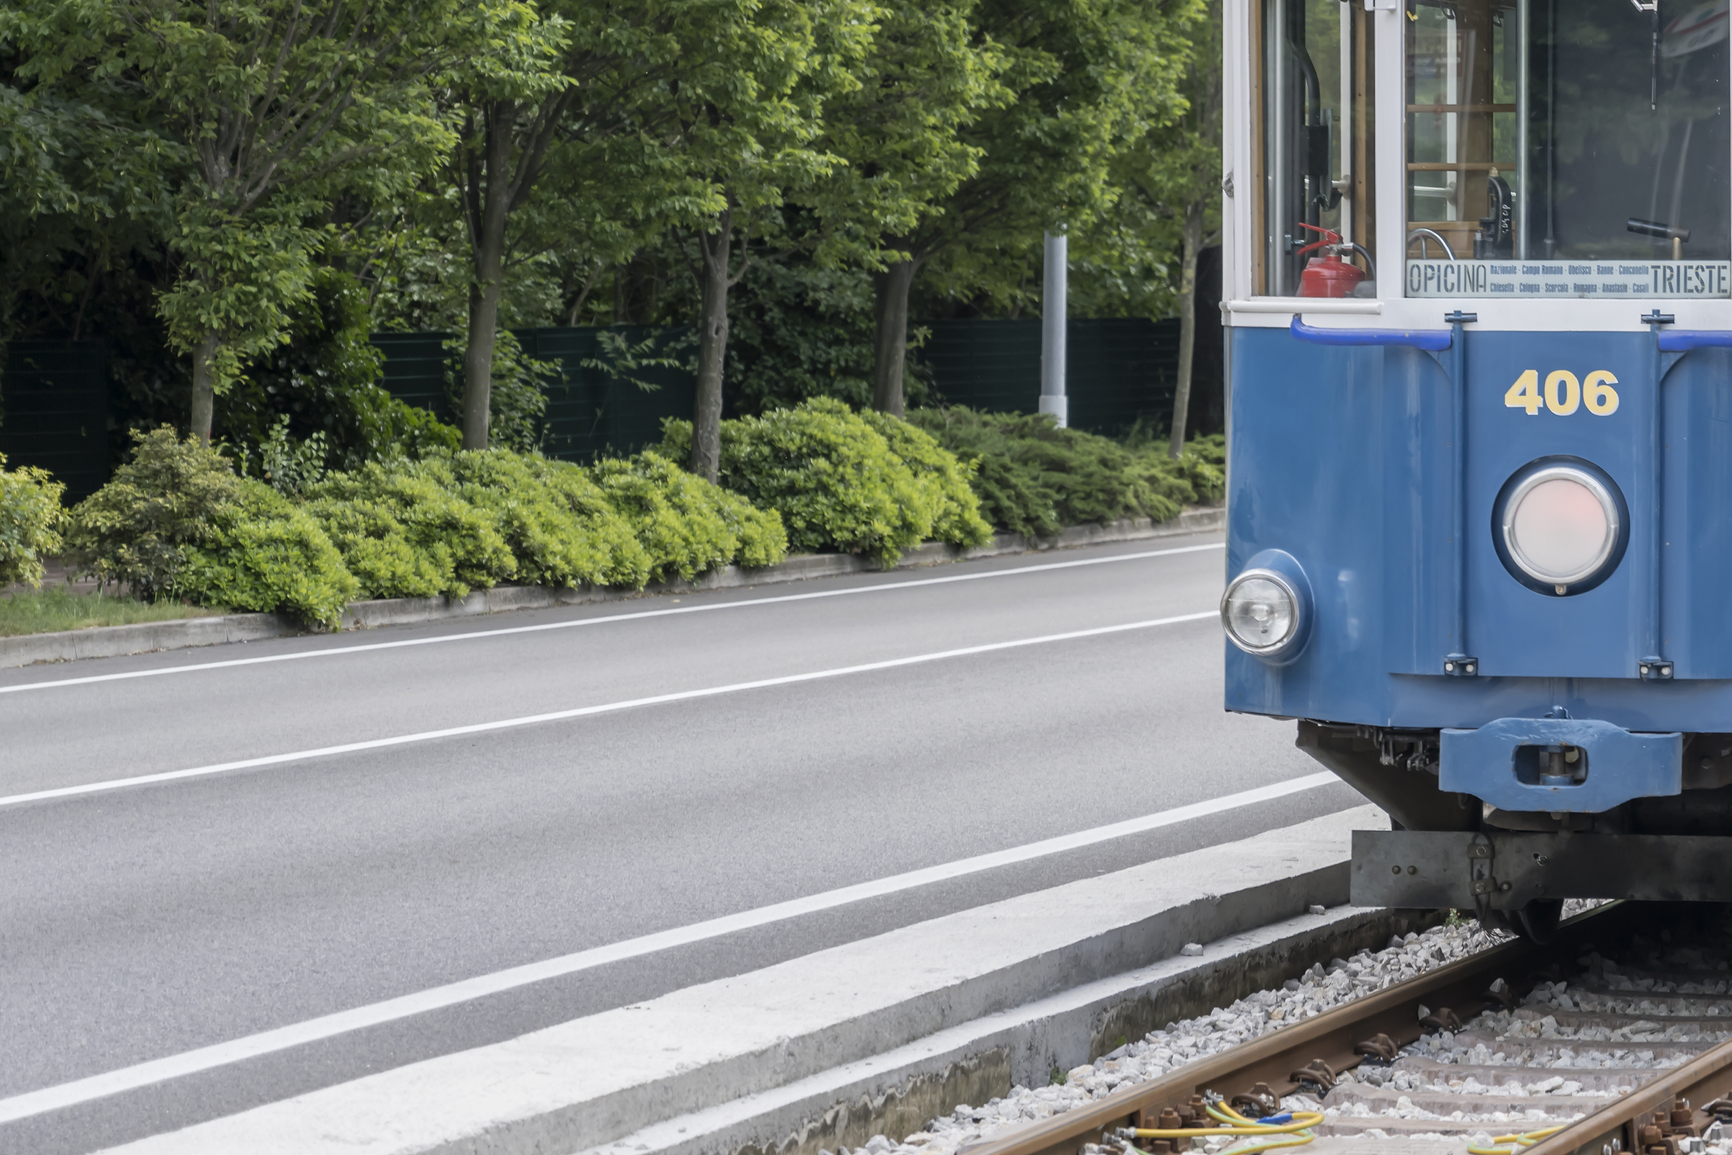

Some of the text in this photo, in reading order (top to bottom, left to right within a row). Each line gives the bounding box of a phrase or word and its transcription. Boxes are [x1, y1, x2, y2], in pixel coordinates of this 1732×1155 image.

[1410, 263, 1487, 293] OPICINA
[1490, 264, 1649, 276] Nazionale Campo Romano Obelisco Banne Conconello
[1650, 264, 1728, 293] TRIESTE
[1519, 282, 1540, 294] Cologna
[1545, 282, 1569, 293] Scorcola
[1573, 282, 1597, 294] Romagna
[1602, 282, 1628, 293] Anastasio
[1632, 282, 1649, 293] Casali
[1504, 369, 1620, 417] 406
